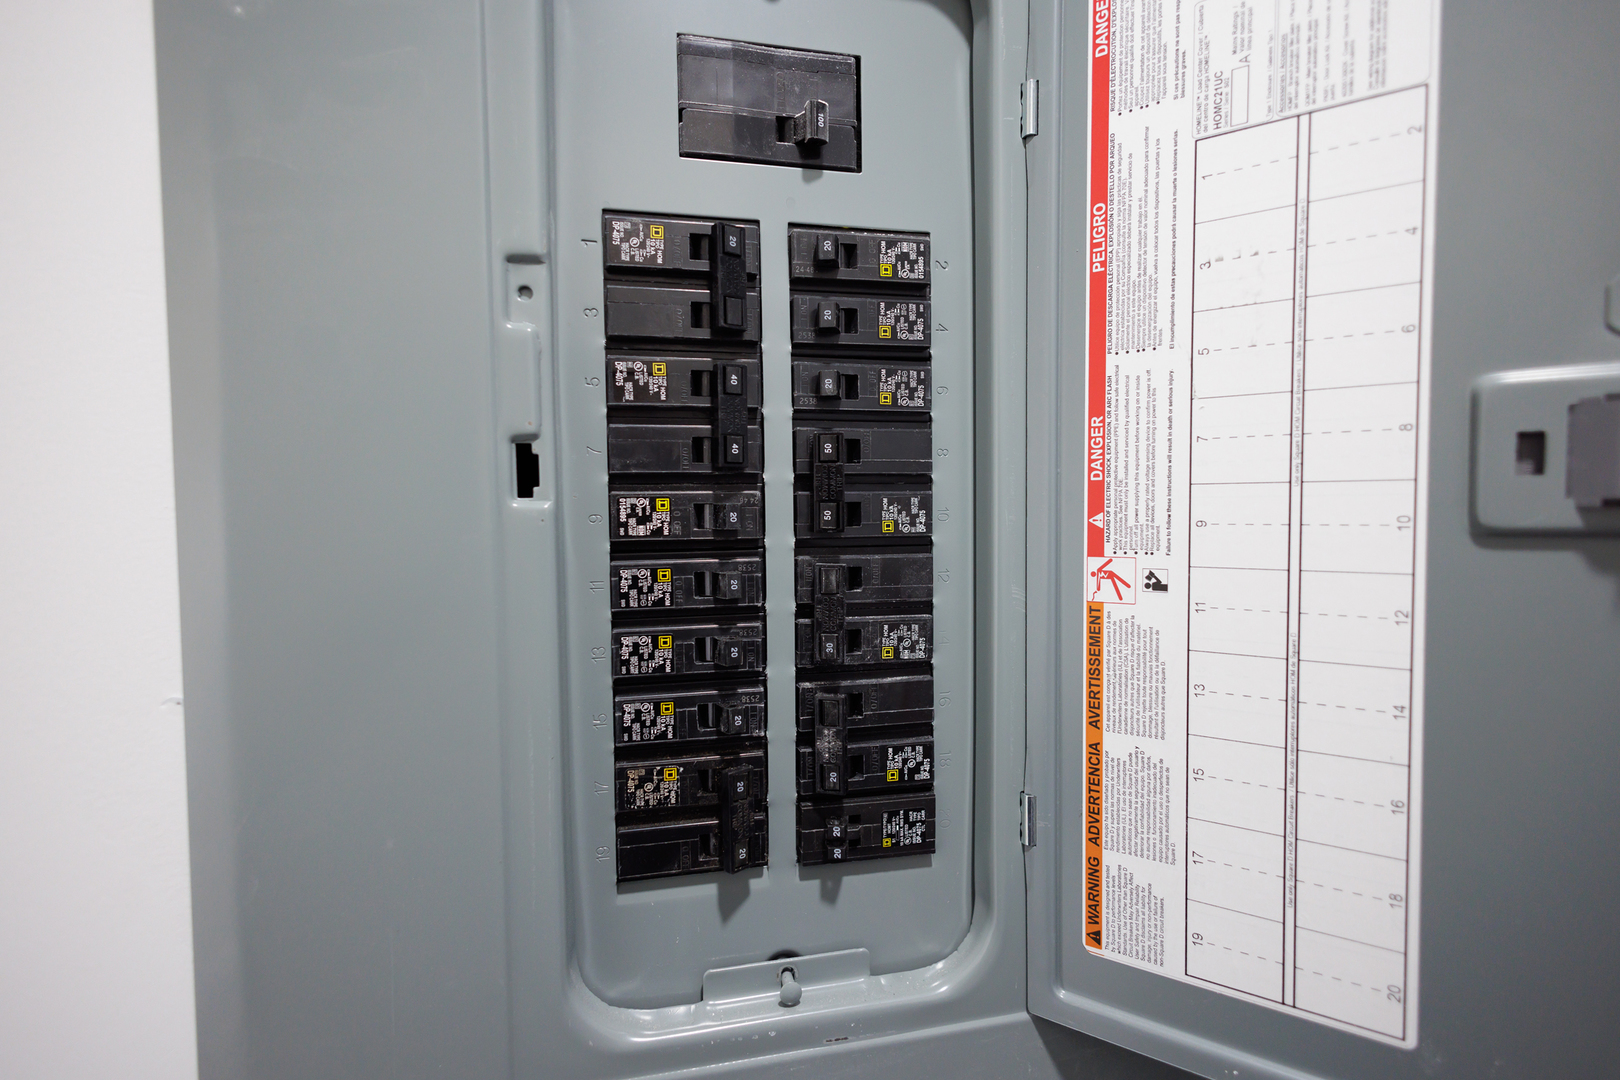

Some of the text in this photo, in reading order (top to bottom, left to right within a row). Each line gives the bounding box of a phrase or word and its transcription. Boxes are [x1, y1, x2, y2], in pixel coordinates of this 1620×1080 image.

[1095, 0, 1108, 58] DANGE
[1239, 54, 1250, 63] A
[1213, 71, 1223, 130] HOMC21UC
[1407, 124, 1423, 135] 2
[1405, 226, 1418, 235] 4
[581, 239, 597, 247] 1
[729, 235, 737, 247] 20
[1093, 203, 1106, 272] PELIGRO
[823, 240, 832, 251] 20
[935, 260, 949, 271] 2
[1199, 260, 1212, 270] 3
[583, 308, 599, 319] 3
[824, 310, 832, 320] 20
[936, 323, 949, 332] 4
[1401, 324, 1416, 333] 6
[1197, 347, 1210, 356] 5
[584, 377, 600, 388] 5
[730, 374, 738, 385] 40
[824, 378, 833, 389] 20
[936, 386, 949, 395] 6
[1398, 423, 1414, 432] 8
[586, 446, 602, 456] 7
[731, 443, 739, 454] 40
[824, 443, 832, 453] 50
[937, 448, 949, 458] 8
[1091, 416, 1103, 481] DANGER
[588, 514, 603, 524] 9
[730, 512, 738, 523] 20
[823, 510, 832, 521] 50
[937, 507, 950, 522] 10
[1396, 515, 1412, 531] 10
[620, 570, 628, 592] DP-4075
[938, 568, 950, 583] 12
[589, 581, 605, 594] 11
[730, 579, 738, 590] 20
[1194, 602, 1206, 614] 11
[1394, 610, 1409, 626] 12
[621, 637, 629, 659] DP-4075
[731, 647, 738, 658] 20
[825, 642, 834, 653] 30
[591, 647, 606, 664] 13
[1193, 684, 1206, 698] 13
[741, 694, 760, 702] 2538
[623, 704, 631, 726] DP-4075
[1392, 705, 1406, 720] 14
[592, 714, 607, 730] 15
[734, 715, 742, 726] 20
[1088, 605, 1101, 925] WARNING ADVERTENCIA AVERTISSEMENT
[829, 772, 837, 783] 20
[1192, 768, 1205, 782] 15
[594, 781, 609, 796] 17
[737, 781, 744, 792] 20
[1390, 800, 1405, 815] 16
[832, 826, 841, 837] 20
[596, 846, 610, 863] 19
[739, 848, 746, 859] 20
[833, 848, 842, 859] 20
[1192, 850, 1203, 865] 17
[1388, 893, 1404, 909] 18
[1191, 932, 1204, 946] 19
[1386, 985, 1402, 1004] 20
